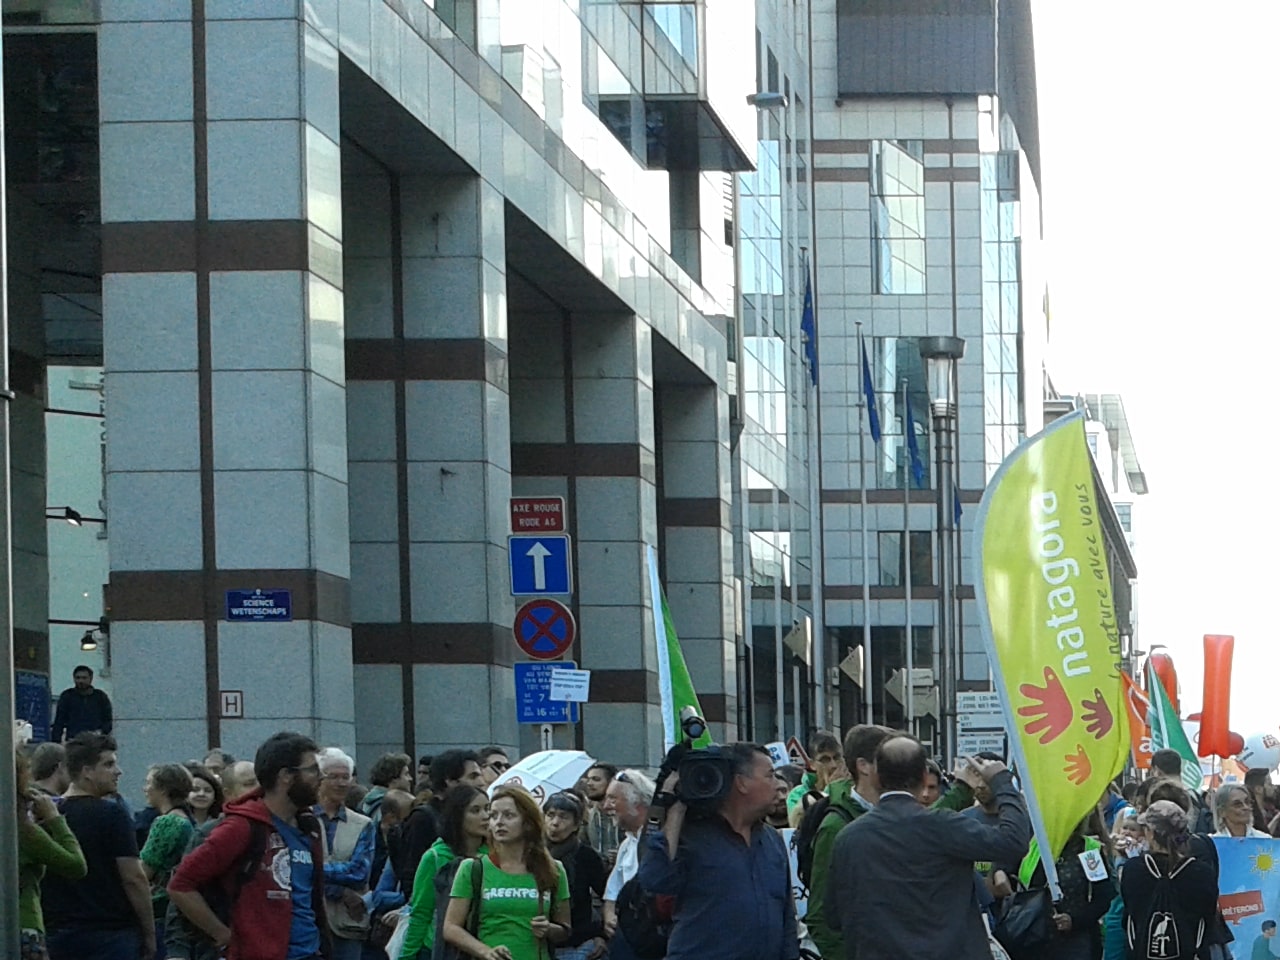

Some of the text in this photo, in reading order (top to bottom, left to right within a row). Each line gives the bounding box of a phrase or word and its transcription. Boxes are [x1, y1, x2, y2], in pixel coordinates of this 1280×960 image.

[513, 503, 560, 513] AXE ROUGE
[1075, 483, 1094, 527] vous
[519, 518, 556, 527] RODE AS
[1086, 534, 1105, 581] avec
[1036, 489, 1092, 678] natagora
[243, 599, 275, 607] SCIENCE
[1097, 588, 1122, 655] nature
[225, 695, 238, 713] H
[538, 693, 545, 703] 7
